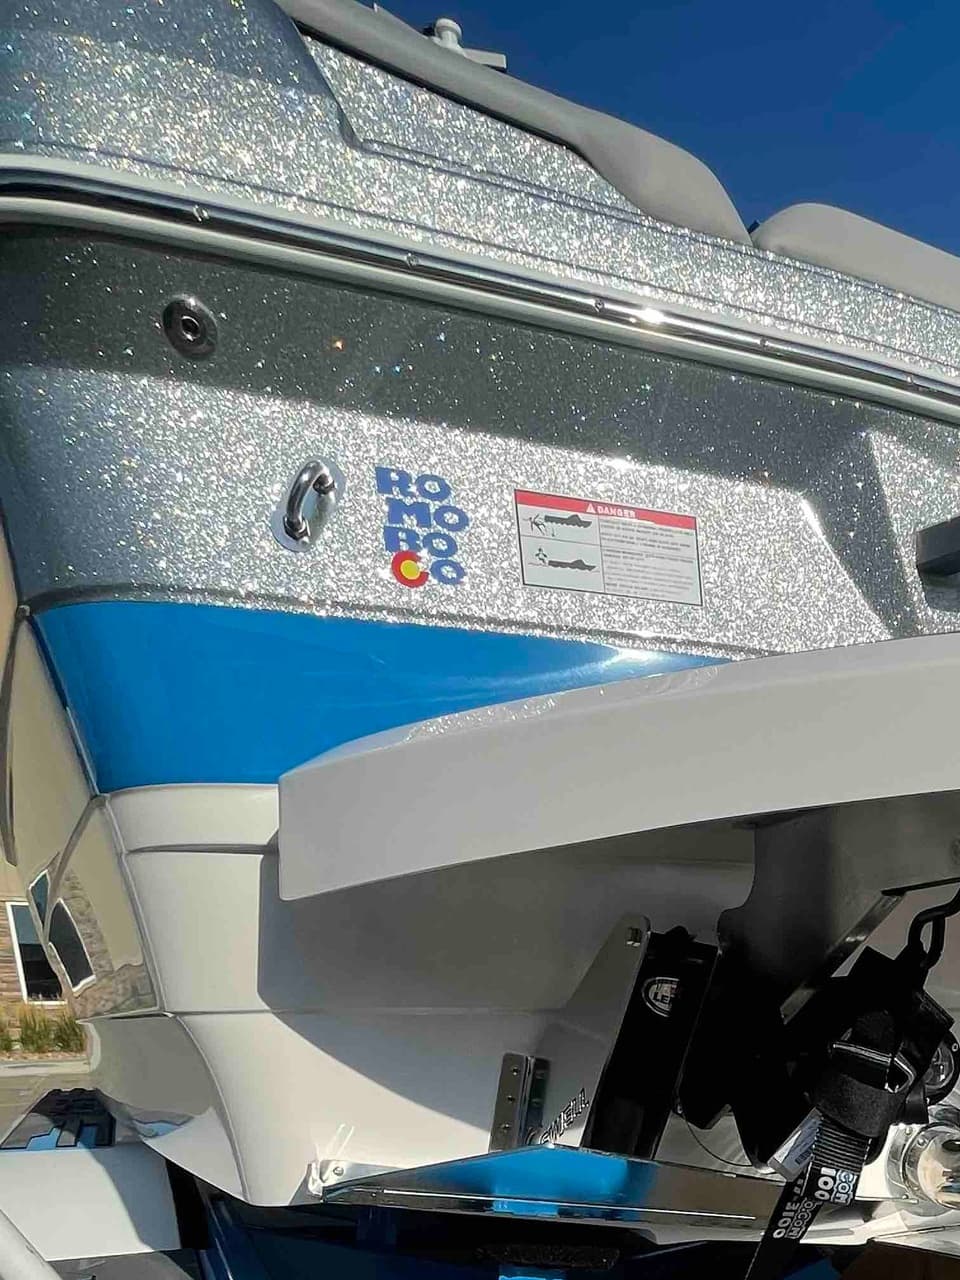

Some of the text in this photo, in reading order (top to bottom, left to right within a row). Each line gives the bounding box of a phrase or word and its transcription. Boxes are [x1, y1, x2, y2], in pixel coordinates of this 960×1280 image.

[375, 466, 451, 500] RO
[386, 497, 470, 532] MO
[597, 505, 636, 518] DANGER
[391, 550, 466, 588] CO
